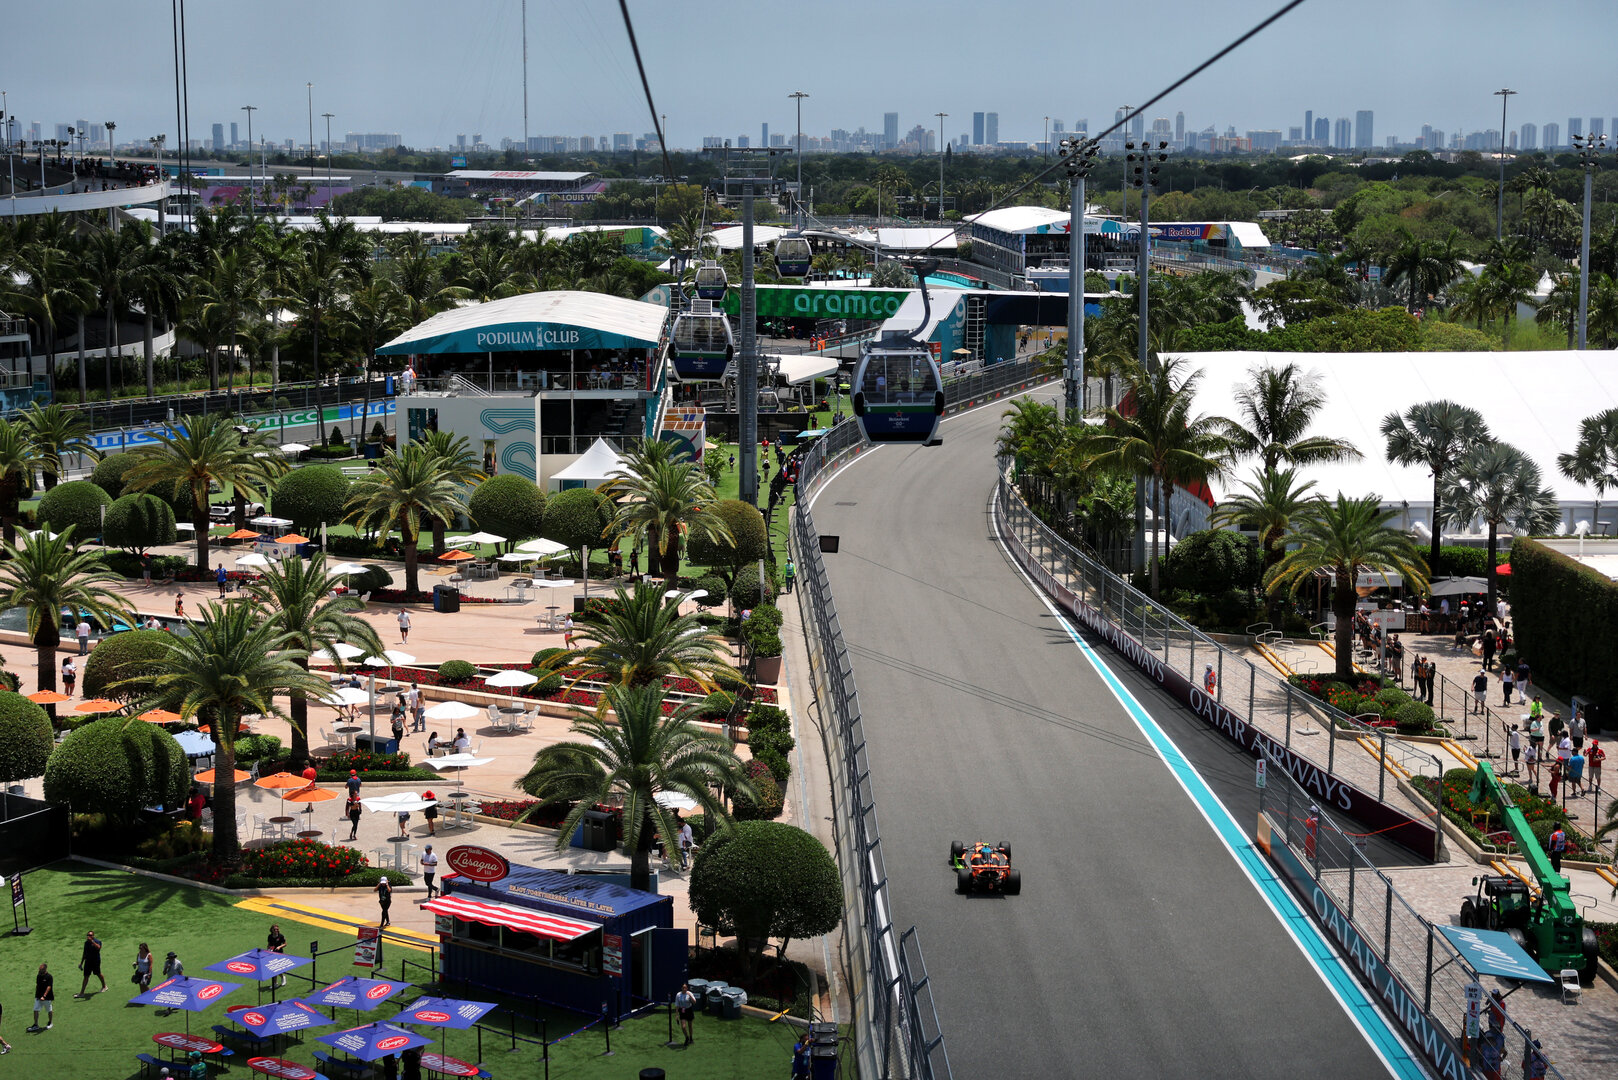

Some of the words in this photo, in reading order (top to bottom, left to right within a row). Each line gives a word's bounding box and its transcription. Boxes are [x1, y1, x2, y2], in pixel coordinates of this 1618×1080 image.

[1169, 227, 1184, 236] Red
[1186, 228, 1200, 236] Bull
[794, 293, 900, 315] aramco
[477, 331, 535, 346] PODIUM
[544, 330, 580, 344] CLUB
[1029, 560, 1059, 599] AIRWAYS
[1073, 599, 1109, 640] QATAR
[1112, 630, 1164, 682] AIRWAYS
[1189, 688, 1246, 746] QATAR
[1250, 732, 1352, 810] AIRWAYS
[453, 852, 499, 876] Lasagna
[1313, 887, 1378, 988] QATAR
[1383, 976, 1469, 1080] AIRWA
[159, 1034, 212, 1051] Barilla
[254, 1059, 307, 1078] Barilla
[421, 1054, 470, 1074] Barilla
